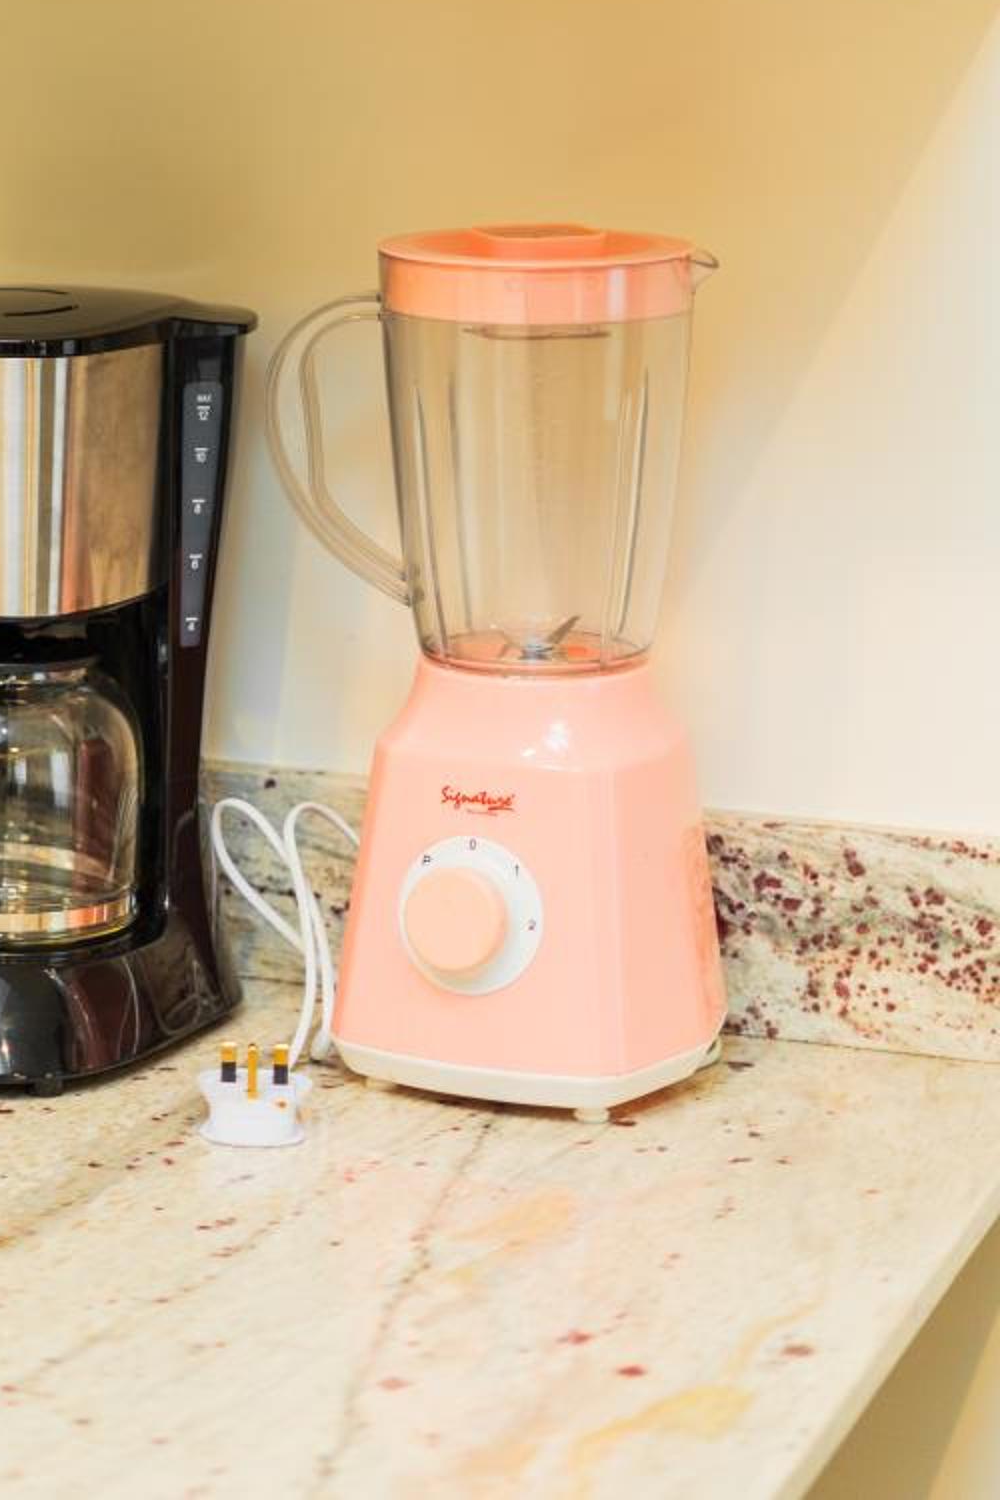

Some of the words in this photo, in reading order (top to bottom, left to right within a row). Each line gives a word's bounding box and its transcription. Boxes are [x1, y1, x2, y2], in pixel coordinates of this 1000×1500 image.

[197, 394, 213, 403] MAX
[198, 411, 209, 421] 12
[195, 452, 206, 463] 10
[441, 785, 516, 811] Signature
